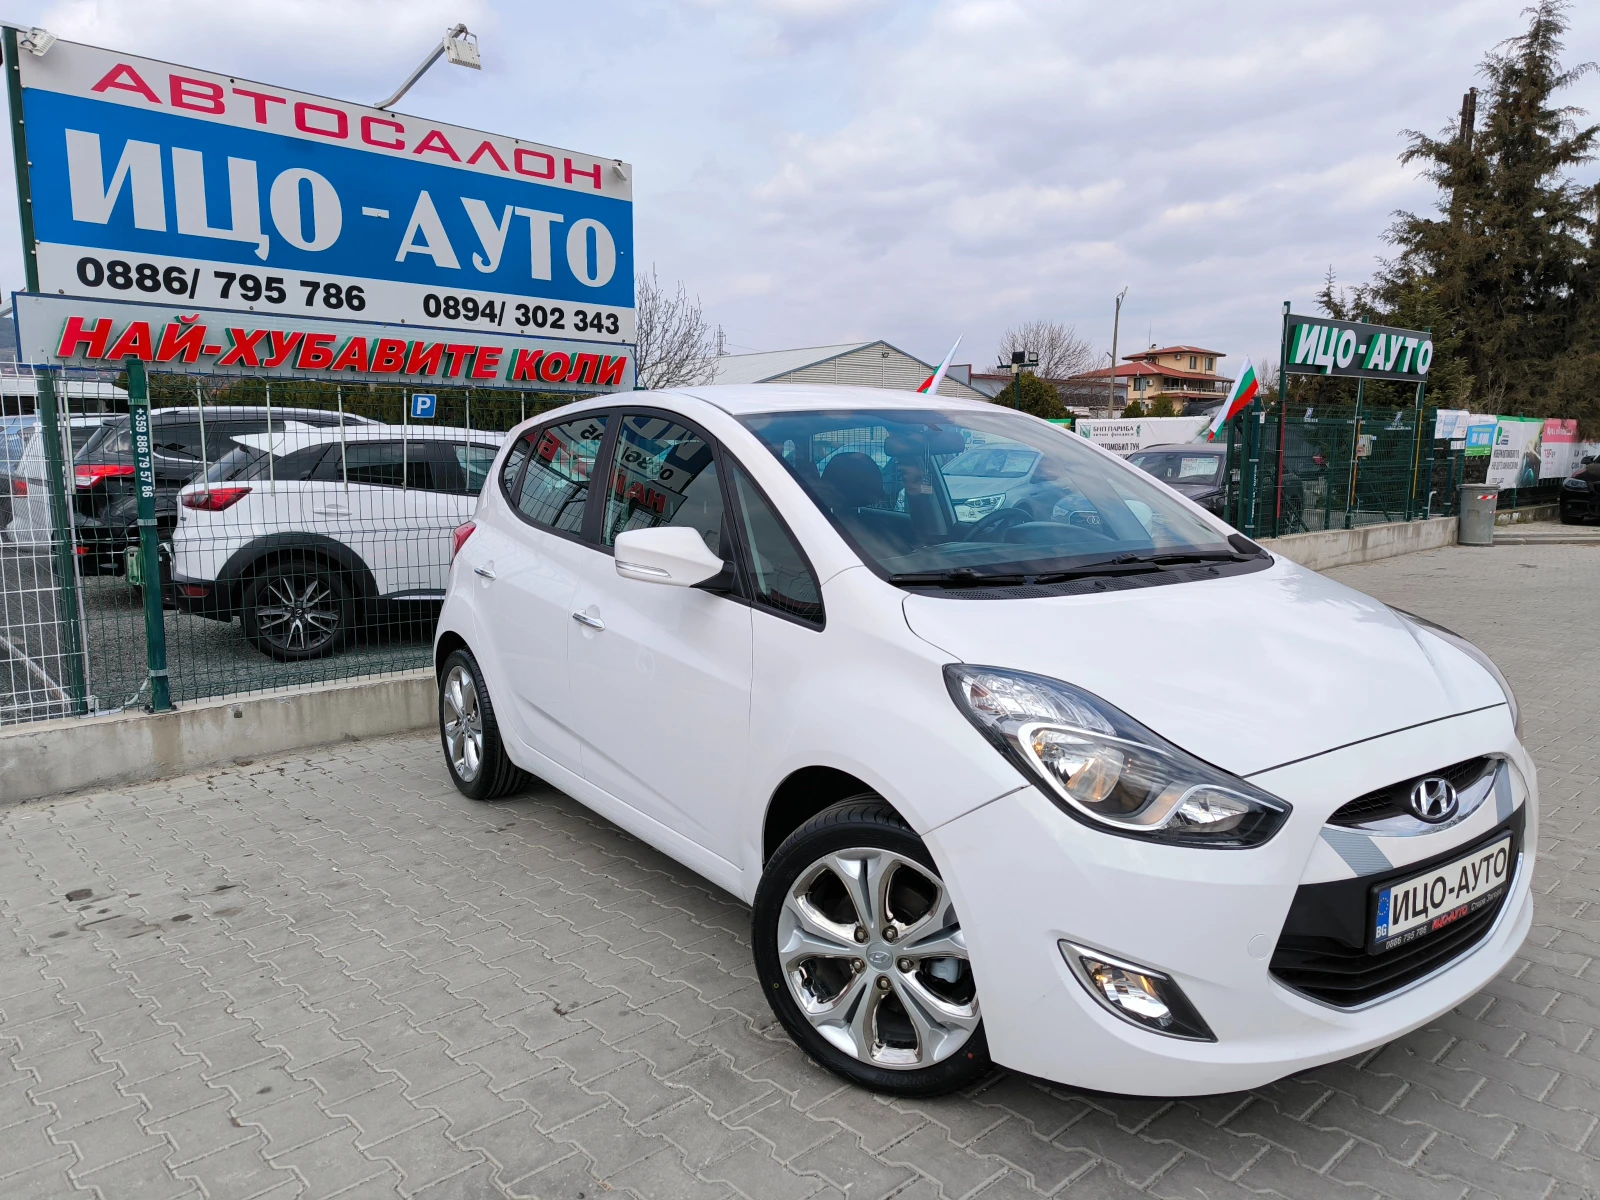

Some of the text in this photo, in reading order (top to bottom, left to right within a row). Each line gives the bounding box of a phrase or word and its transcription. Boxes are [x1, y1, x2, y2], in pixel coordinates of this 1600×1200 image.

[90, 63, 602, 190] АВТОСАЛОН
[76, 256, 620, 335] 0886/ 795 786 0894/ 302 343
[55, 313, 628, 386] НАЙ-ХУБАВИТЕ КОЛИ
[1289, 323, 1434, 375] ИЦО-АУТО
[416, 397, 431, 415] P
[135, 407, 154, 498] +359 886 79 57 86
[1392, 847, 1507, 926] ИЦО-АУТО
[1375, 923, 1387, 939] BG
